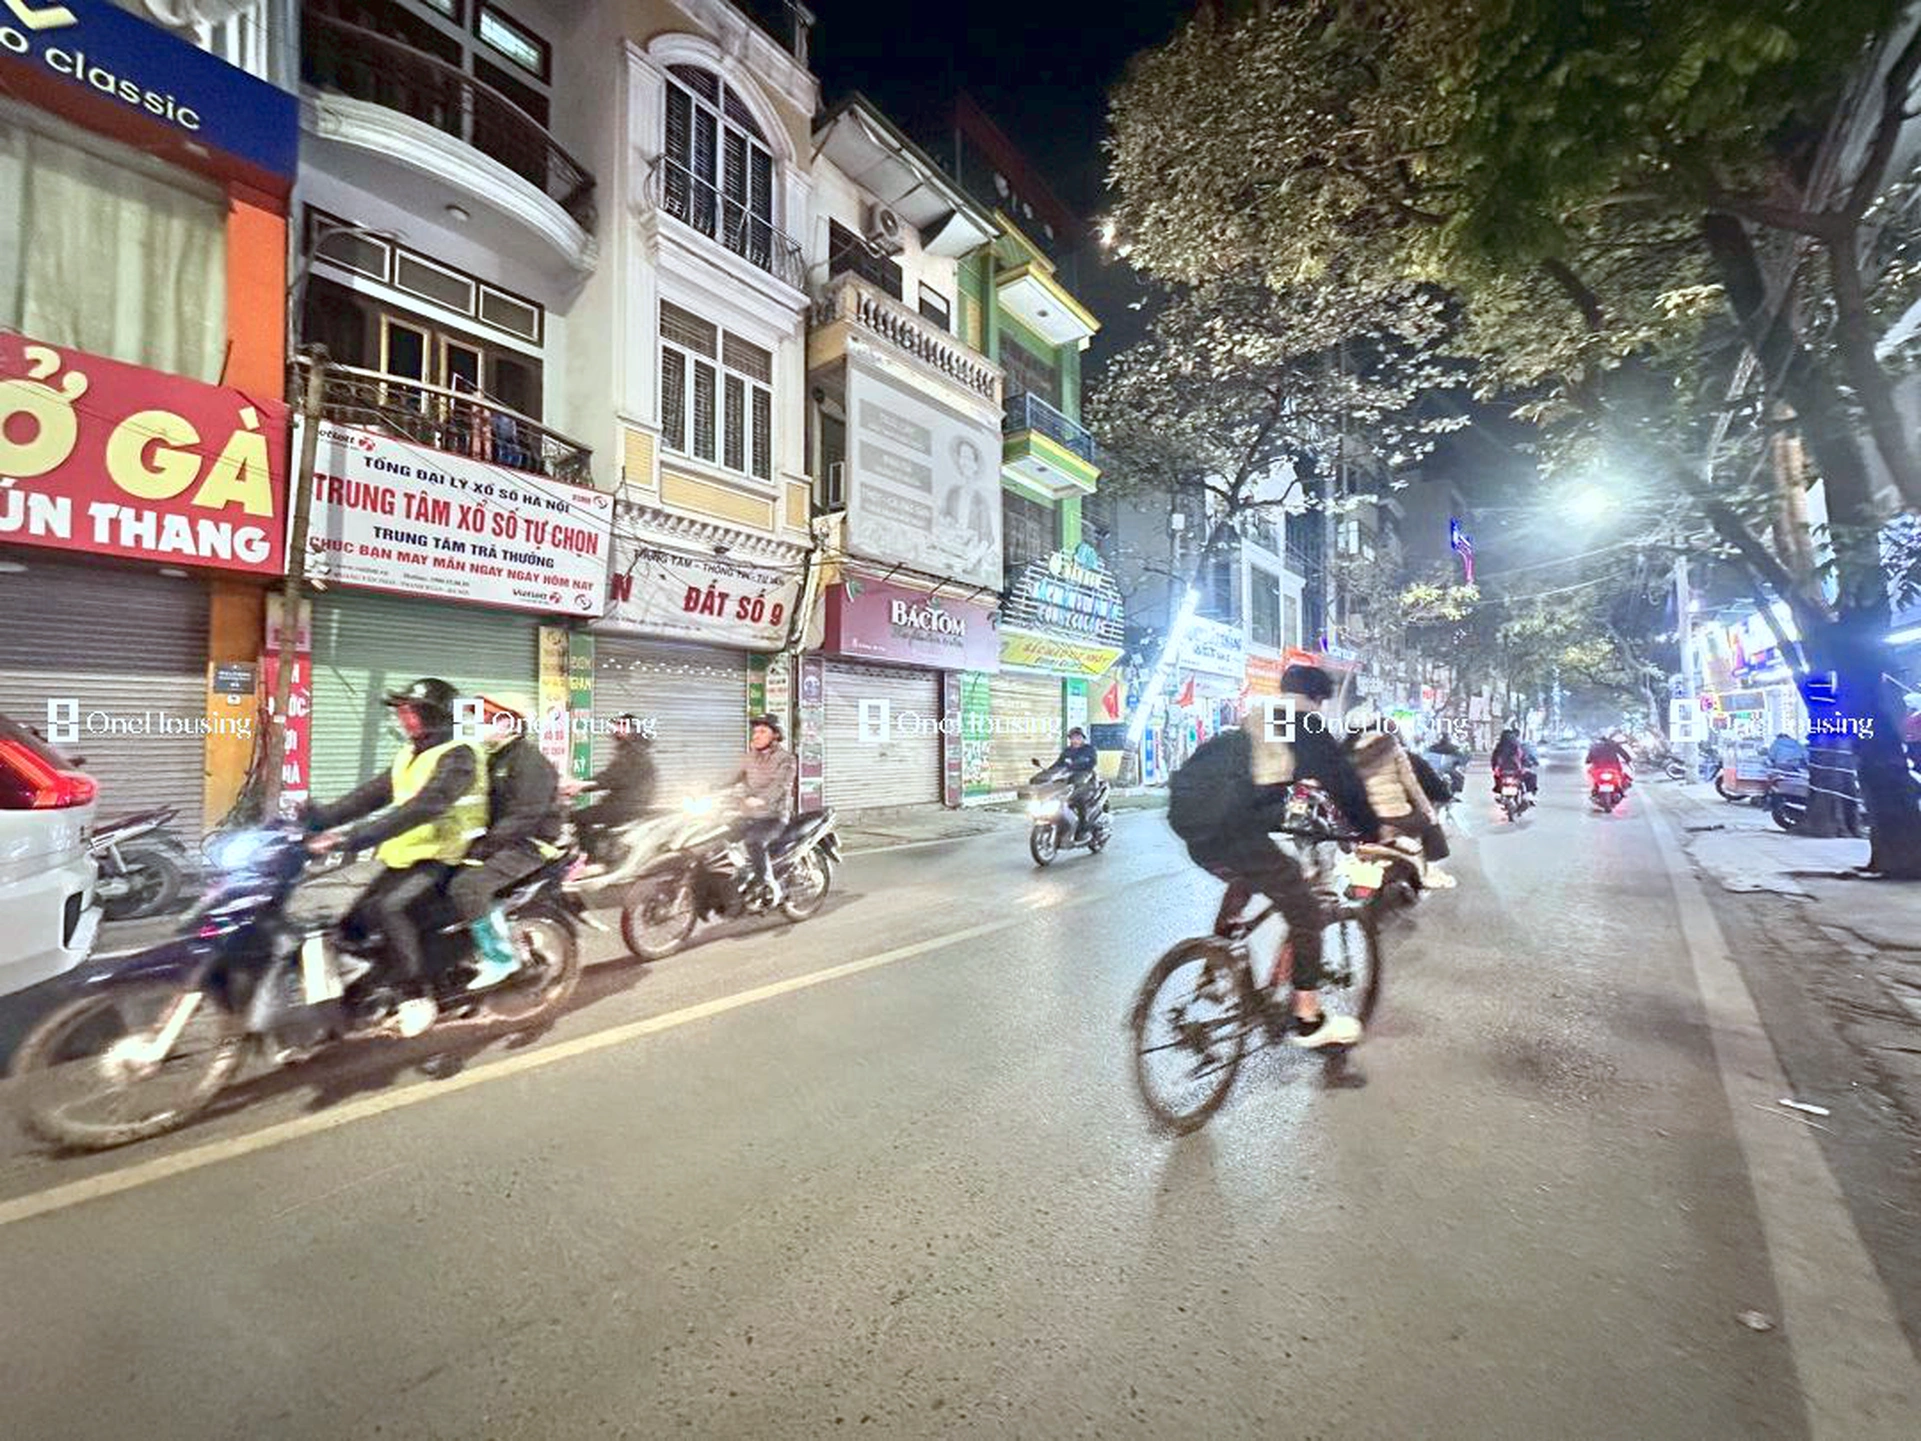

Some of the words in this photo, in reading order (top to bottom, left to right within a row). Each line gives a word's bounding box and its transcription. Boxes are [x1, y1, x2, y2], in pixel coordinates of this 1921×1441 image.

[45, 48, 201, 131] classic
[106, 406, 274, 518] GÀ
[364, 455, 411, 477] TỔNG
[416, 469, 444, 486] ĐẠI
[88, 501, 271, 563] THANG
[312, 472, 396, 516] TRUNG
[403, 490, 450, 527] TÂM
[457, 499, 487, 533] XỔ
[492, 508, 519, 540] SỐ
[524, 519, 549, 550] TỰ
[551, 524, 599, 557] CHỌN
[373, 526, 428, 547] TRUNG
[432, 536, 466, 553] TÂM
[470, 543, 497, 559] TRẢ
[502, 548, 555, 569] THƯỞNG
[397, 551, 428, 566] MAY
[469, 561, 503, 577] NGAY
[572, 580, 594, 592] NAY
[683, 578, 729, 617] ĐẤT
[736, 588, 766, 623] SỐ
[769, 603, 784, 627] 9
